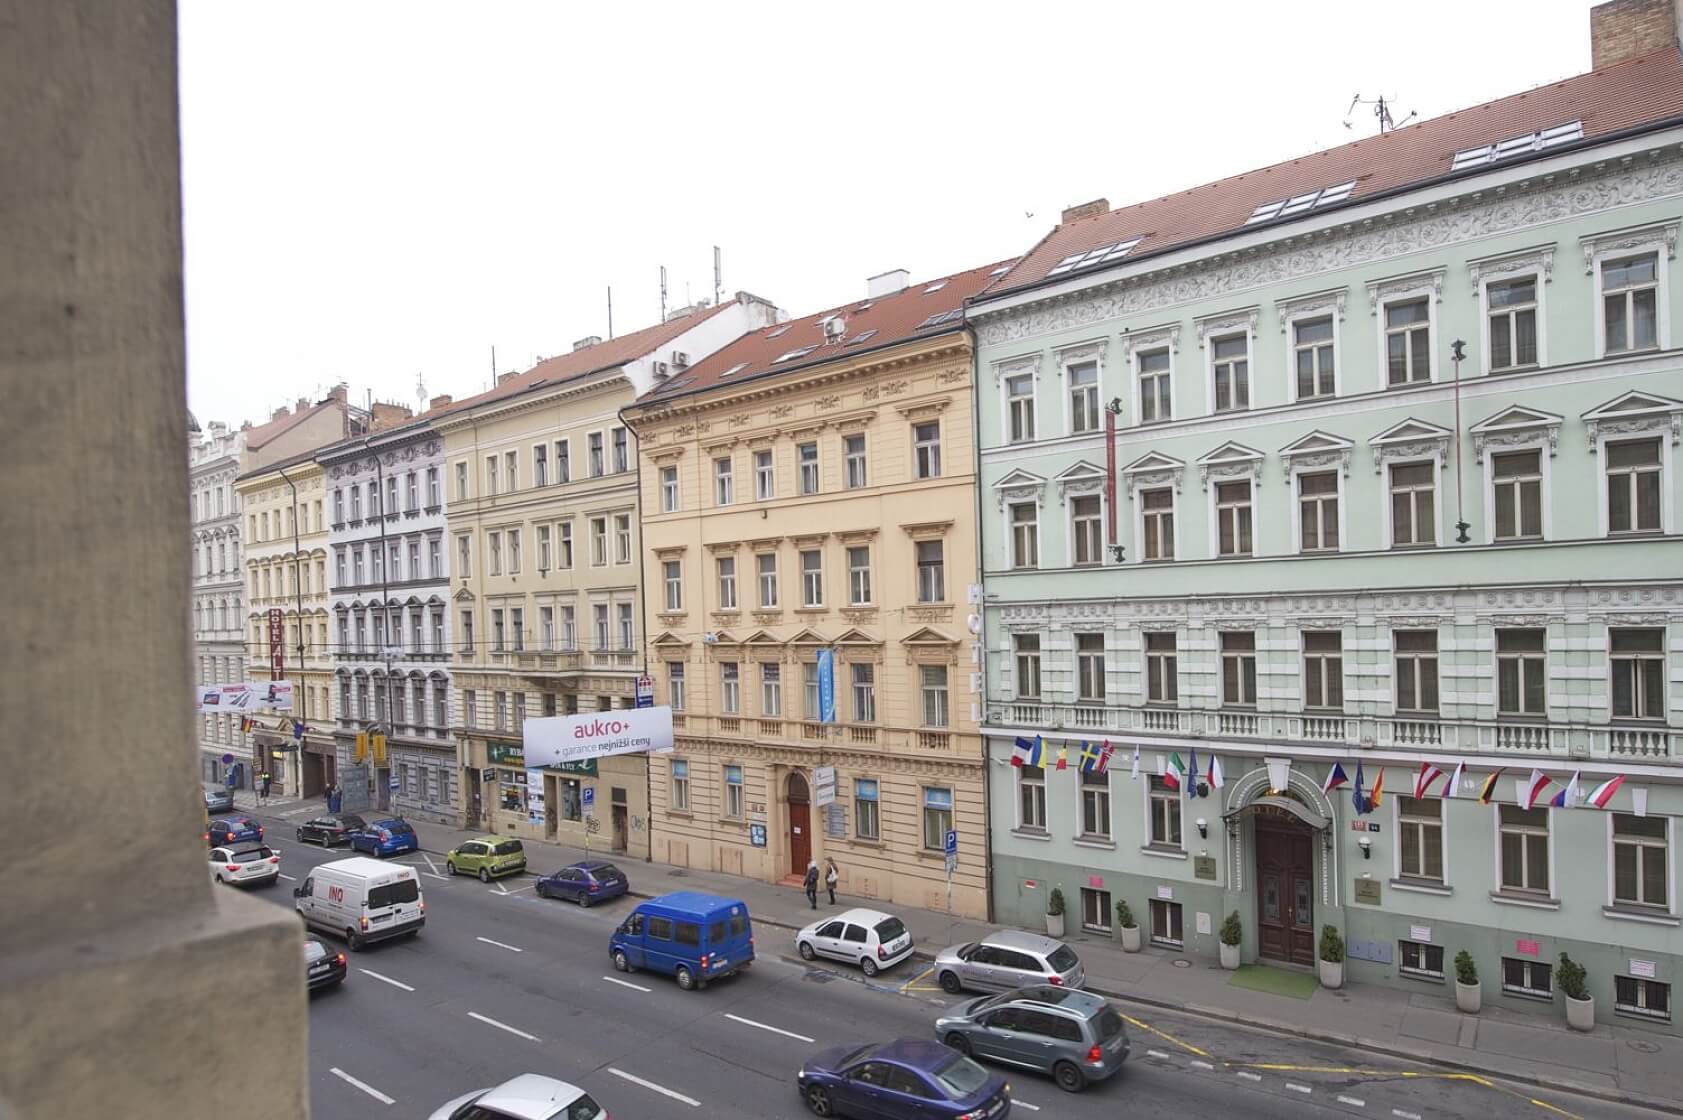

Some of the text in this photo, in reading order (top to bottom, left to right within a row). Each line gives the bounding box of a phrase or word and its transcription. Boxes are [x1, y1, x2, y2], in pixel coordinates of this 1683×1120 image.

[271, 609, 281, 642] HOTEL
[272, 644, 282, 680] ALT
[562, 743, 597, 757] garance
[598, 737, 630, 751] nejnižší
[631, 737, 651, 746] ceny
[584, 788, 592, 800] P
[947, 832, 955, 849] P
[329, 885, 344, 902] INO
